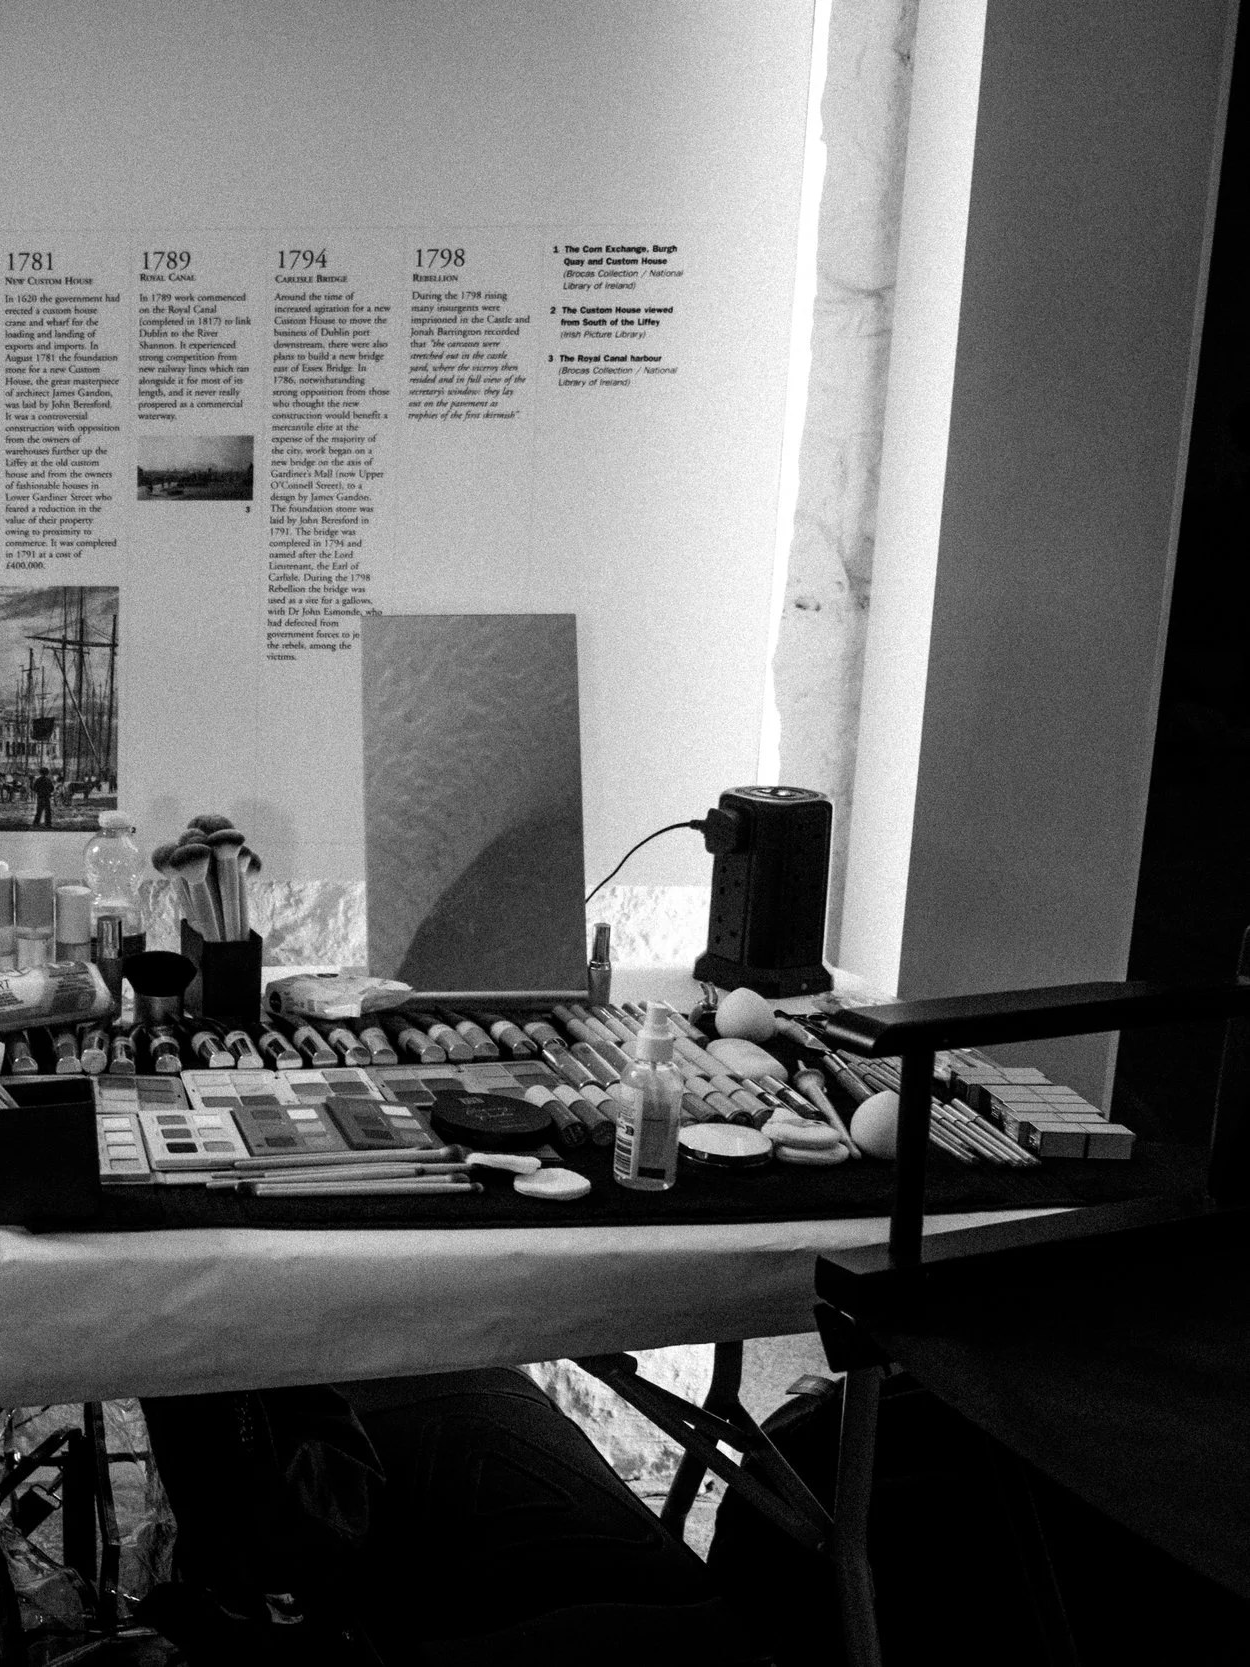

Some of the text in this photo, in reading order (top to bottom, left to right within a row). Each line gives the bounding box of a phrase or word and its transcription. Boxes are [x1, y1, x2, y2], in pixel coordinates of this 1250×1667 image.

[565, 245, 580, 253] The
[605, 245, 650, 254] Exchange,
[652, 245, 678, 254] Burgh
[6, 251, 55, 271] 1781
[141, 250, 191, 271] 1789
[277, 249, 328, 270] 1794
[415, 248, 466, 268] 1798
[564, 257, 668, 267] Quay and Custom House
[562, 269, 595, 279] (Brocas
[598, 269, 639, 278] Collection
[649, 269, 684, 278] National
[563, 282, 636, 291] Library of Ireland)
[4, 294, 121, 306] In 1620 the government had
[139, 293, 247, 302] In 1789 work commenced
[411, 291, 508, 303] During the 1798 rising
[152, 305, 166, 314] the
[167, 305, 191, 317] Royal
[192, 305, 218, 314] Canal
[562, 306, 577, 315] The
[580, 306, 613, 315] Custom
[615, 306, 642, 315] House
[644, 306, 674, 315] viewed
[411, 315, 531, 327] imprisoned in the Castle and
[560, 318, 660, 328] from South of the Liffey
[138, 329, 218, 338] Dublin to the River
[560, 330, 647, 340] (Irish Picture Library)
[6, 353, 118, 365] August 1781 the foundation
[273, 352, 295, 364] plans
[297, 352, 306, 361] to
[308, 352, 330, 361] build
[358, 352, 384, 364] bridge
[559, 355, 575, 363] The
[577, 355, 601, 364] Royal
[603, 355, 628, 363] Canal
[630, 355, 662, 363] harbour
[558, 367, 590, 376] (Brocas
[592, 367, 633, 375] Collection
[643, 367, 678, 375] National
[558, 379, 631, 388] Library of Ireland)
[4, 469, 28, 478] house
[30, 469, 46, 478] and
[47, 469, 67, 478] from
[69, 469, 82, 478] the
[5, 492, 112, 501] Lower Gardiner Street who
[269, 538, 363, 550] completed in 1794 and
[268, 584, 306, 593] Rebellion
[308, 584, 321, 593] the
[323, 584, 348, 596] bridge
